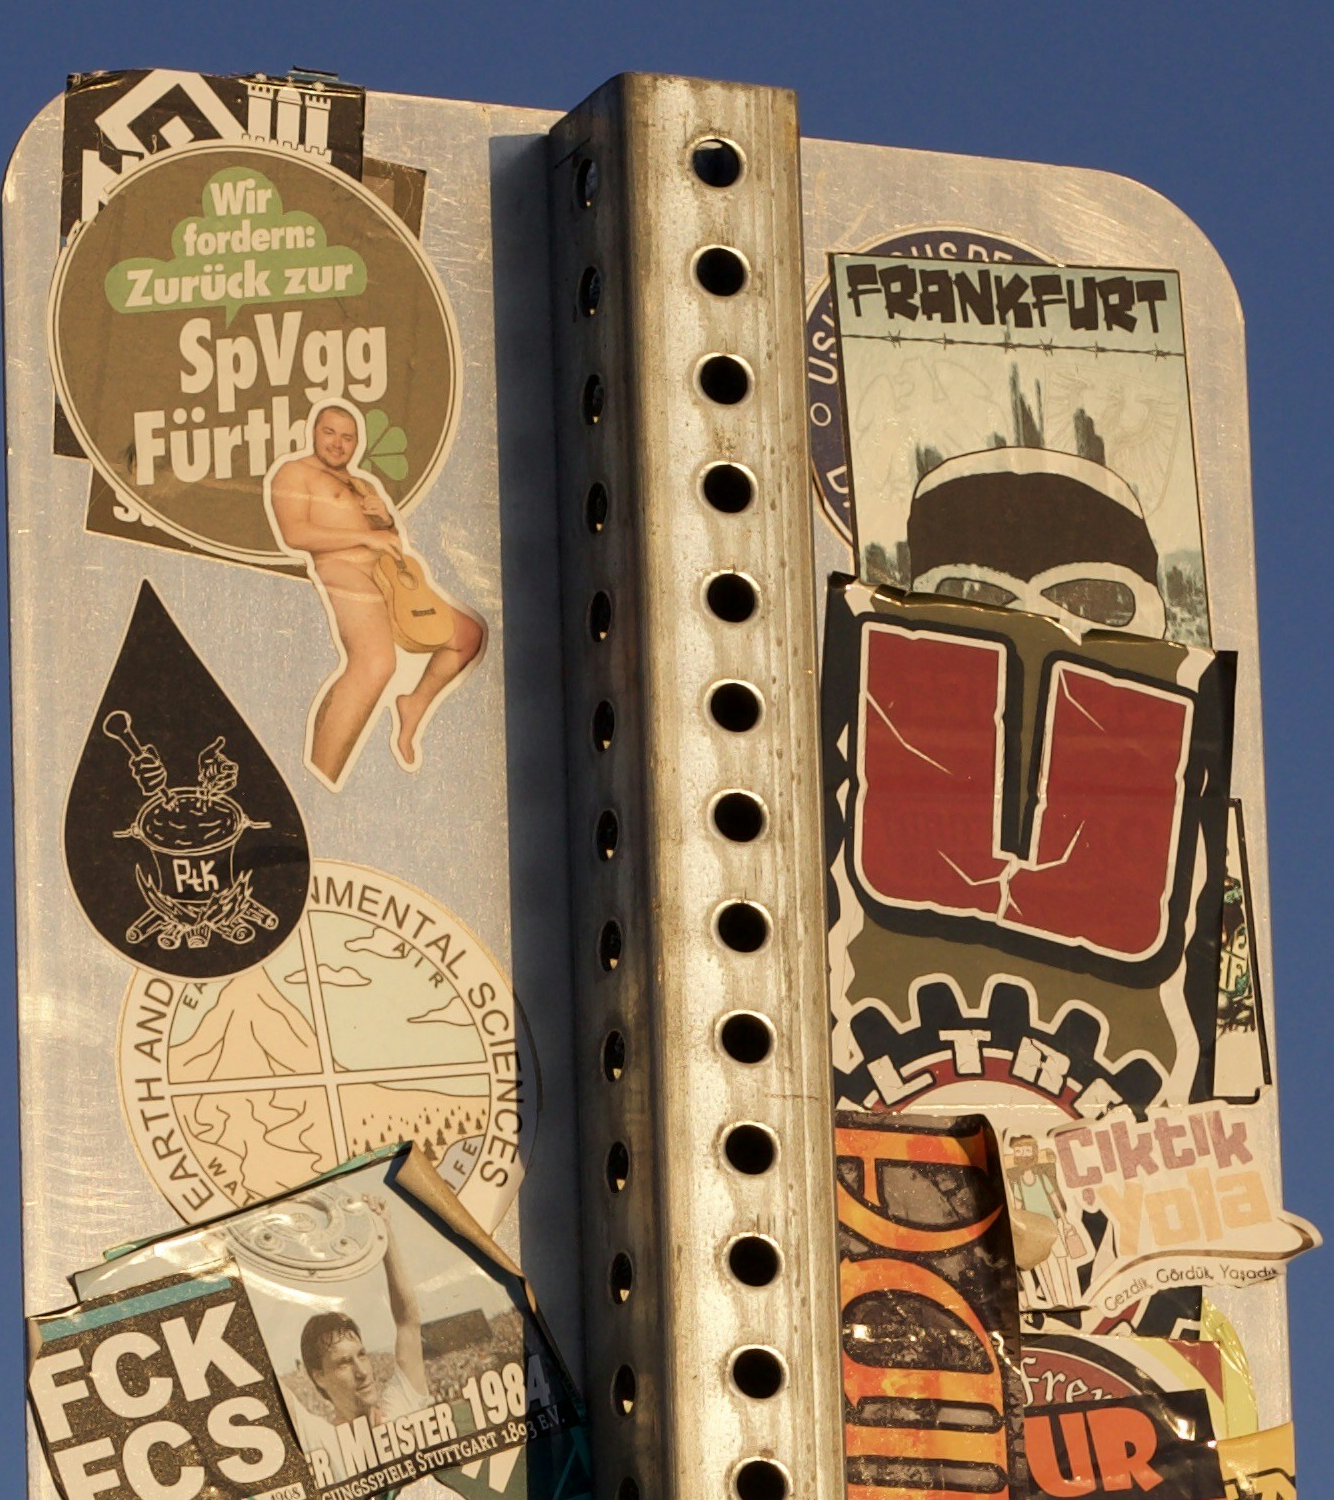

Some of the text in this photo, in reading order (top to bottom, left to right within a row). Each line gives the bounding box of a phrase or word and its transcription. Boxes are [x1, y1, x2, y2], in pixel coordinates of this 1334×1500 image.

[182, 222, 317, 258] fordern:
[210, 177, 273, 216] Wir
[124, 258, 355, 309] Zurück zur
[845, 262, 1168, 334] FRANKFURT
[178, 310, 388, 415] SpVgg
[134, 977, 175, 1064] AND
[467, 982, 526, 1189] SCIENCES
[134, 1077, 216, 1212] EARTH
[1098, 1168, 1274, 1258] Yola
[29, 1300, 266, 1443] FCK
[461, 1354, 552, 1431] 1984
